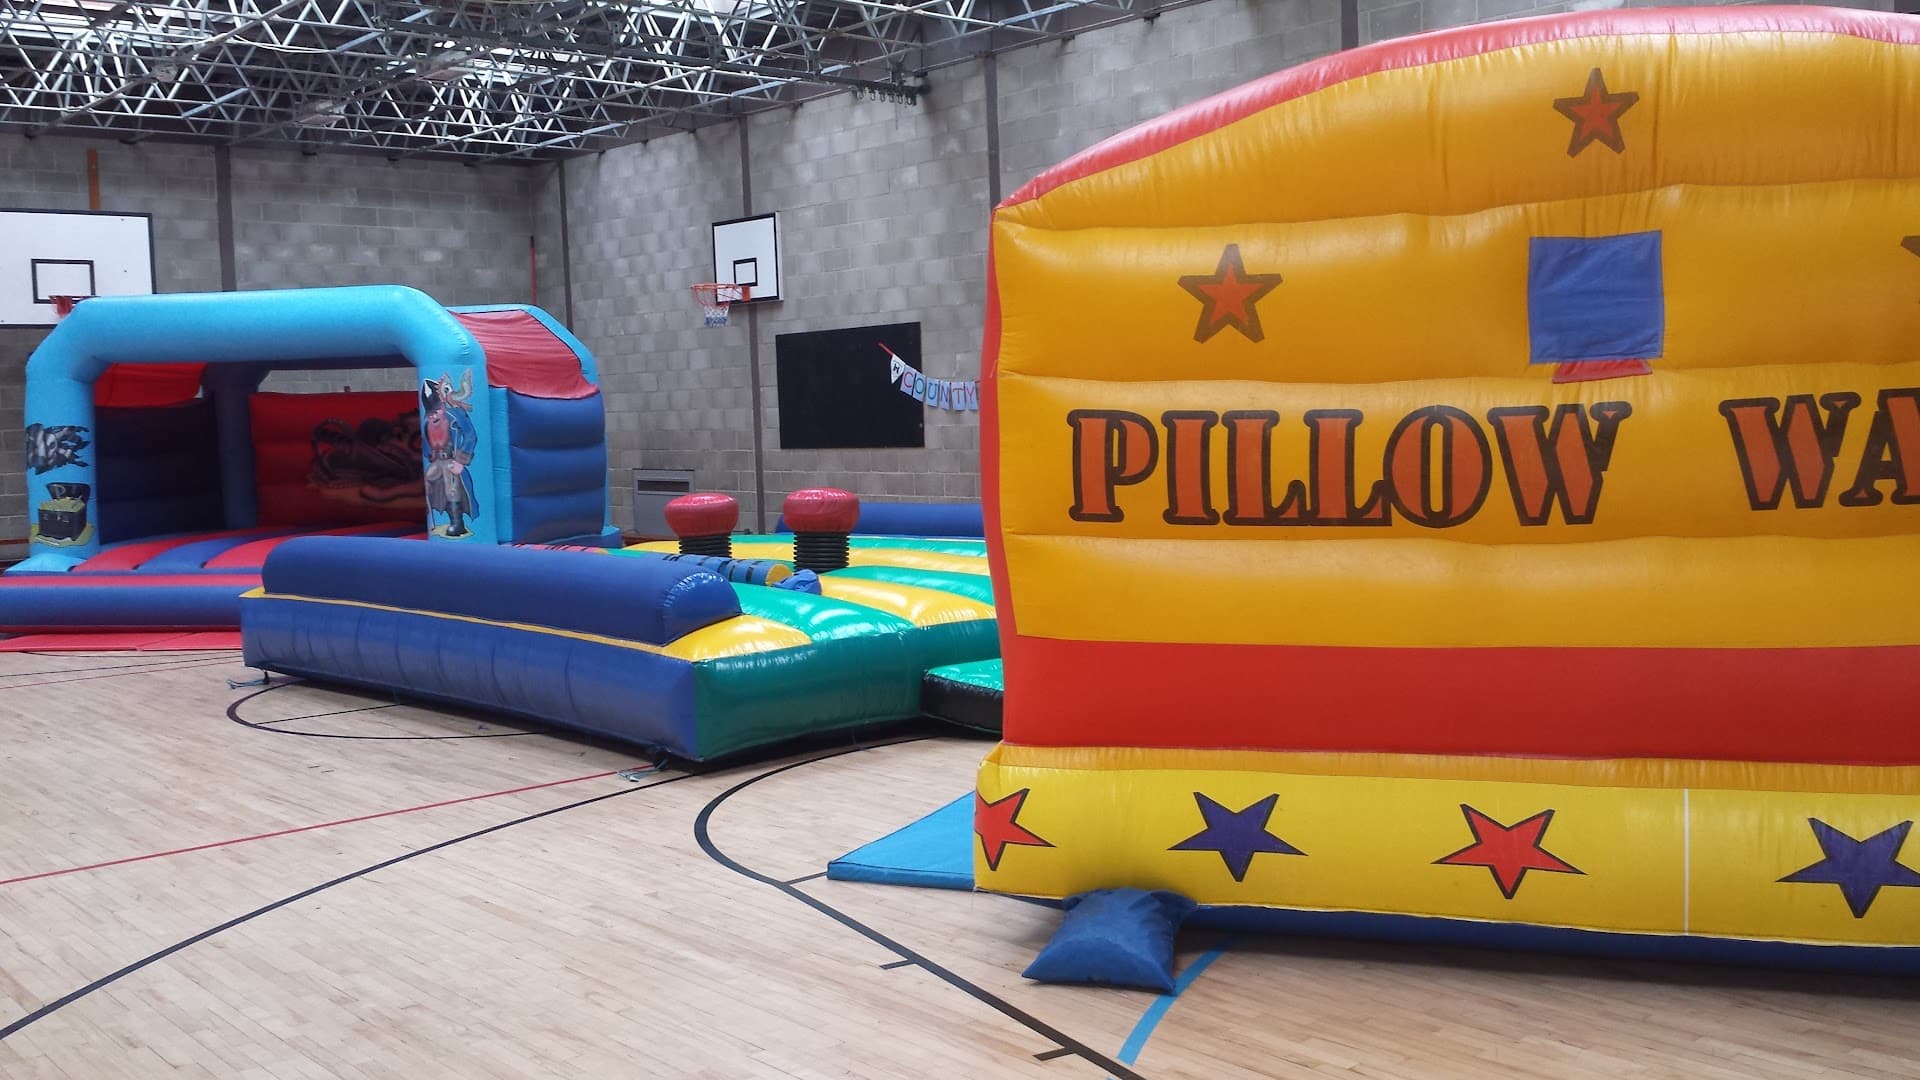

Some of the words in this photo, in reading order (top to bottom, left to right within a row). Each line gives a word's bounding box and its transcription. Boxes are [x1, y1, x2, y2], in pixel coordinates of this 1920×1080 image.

[903, 371, 976, 404] COUNTY
[1067, 401, 1632, 528] PILLOW
[1718, 387, 1920, 511] WA
